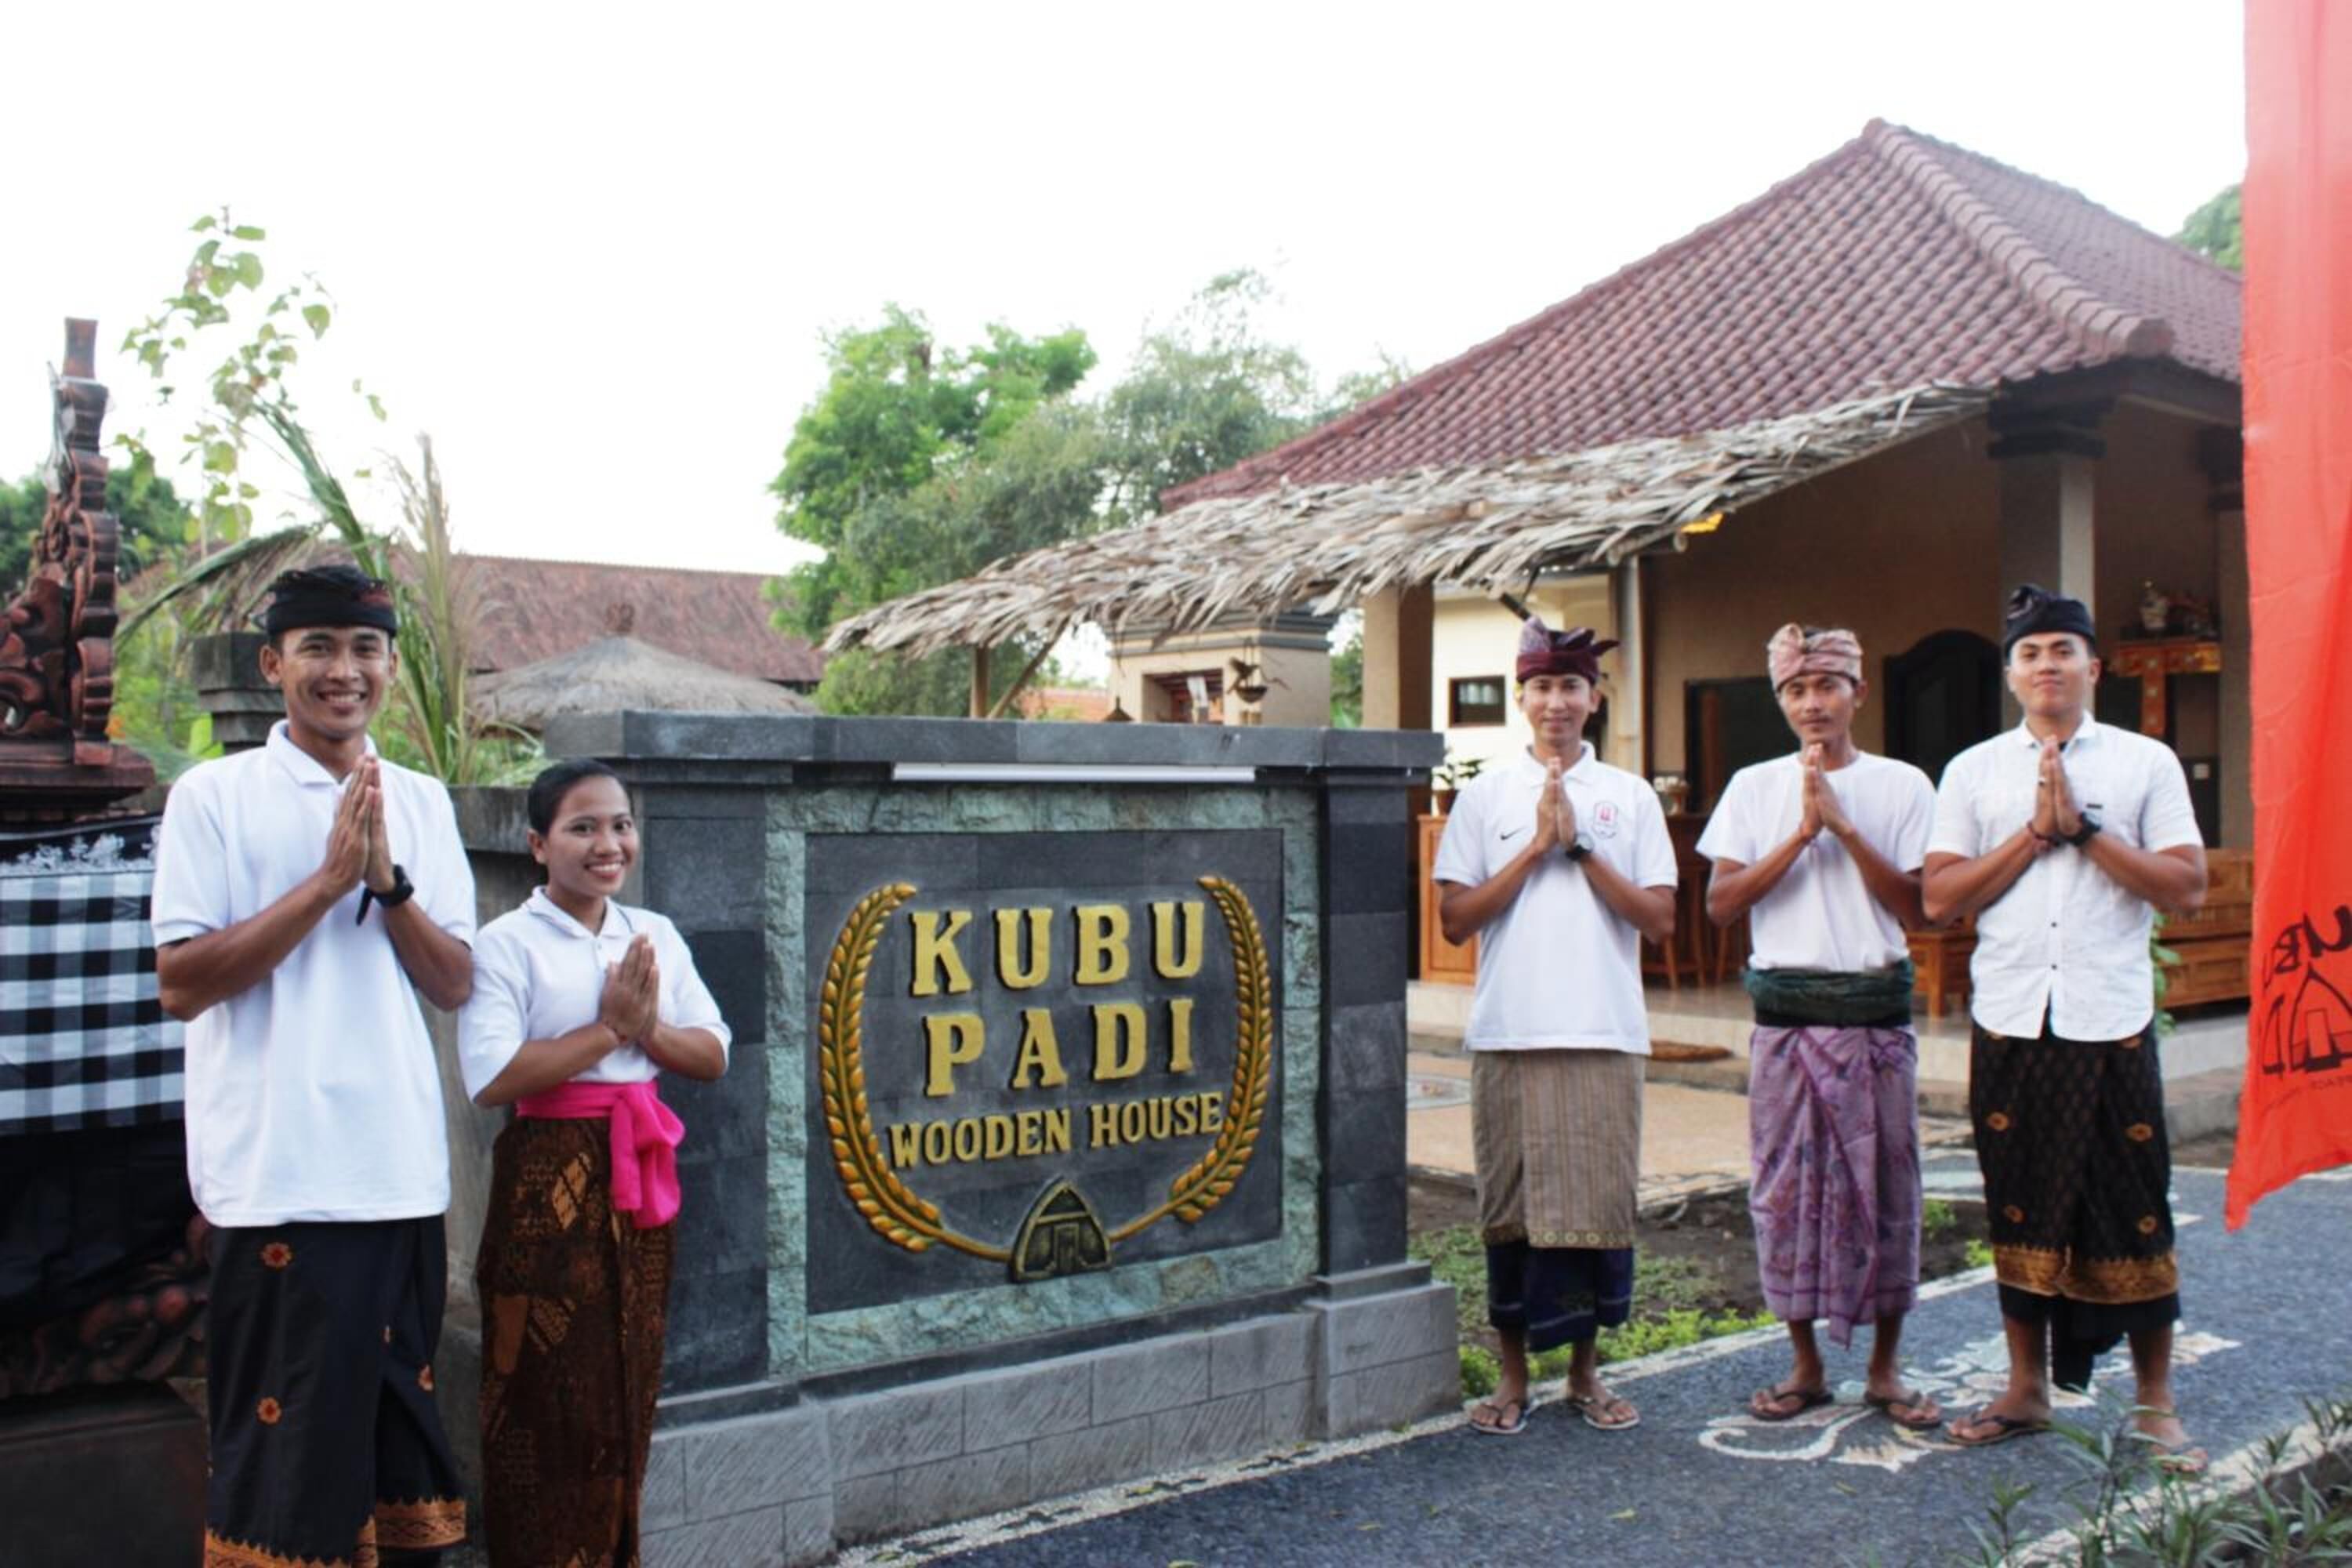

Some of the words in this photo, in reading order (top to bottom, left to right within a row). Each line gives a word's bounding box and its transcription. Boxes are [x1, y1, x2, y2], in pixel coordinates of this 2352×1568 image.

[910, 902, 1205, 996] KUBU
[924, 998, 1193, 1097] PADI
[889, 1109, 1072, 1168] WOODEN
[1091, 1091, 1224, 1148] HOUSE
